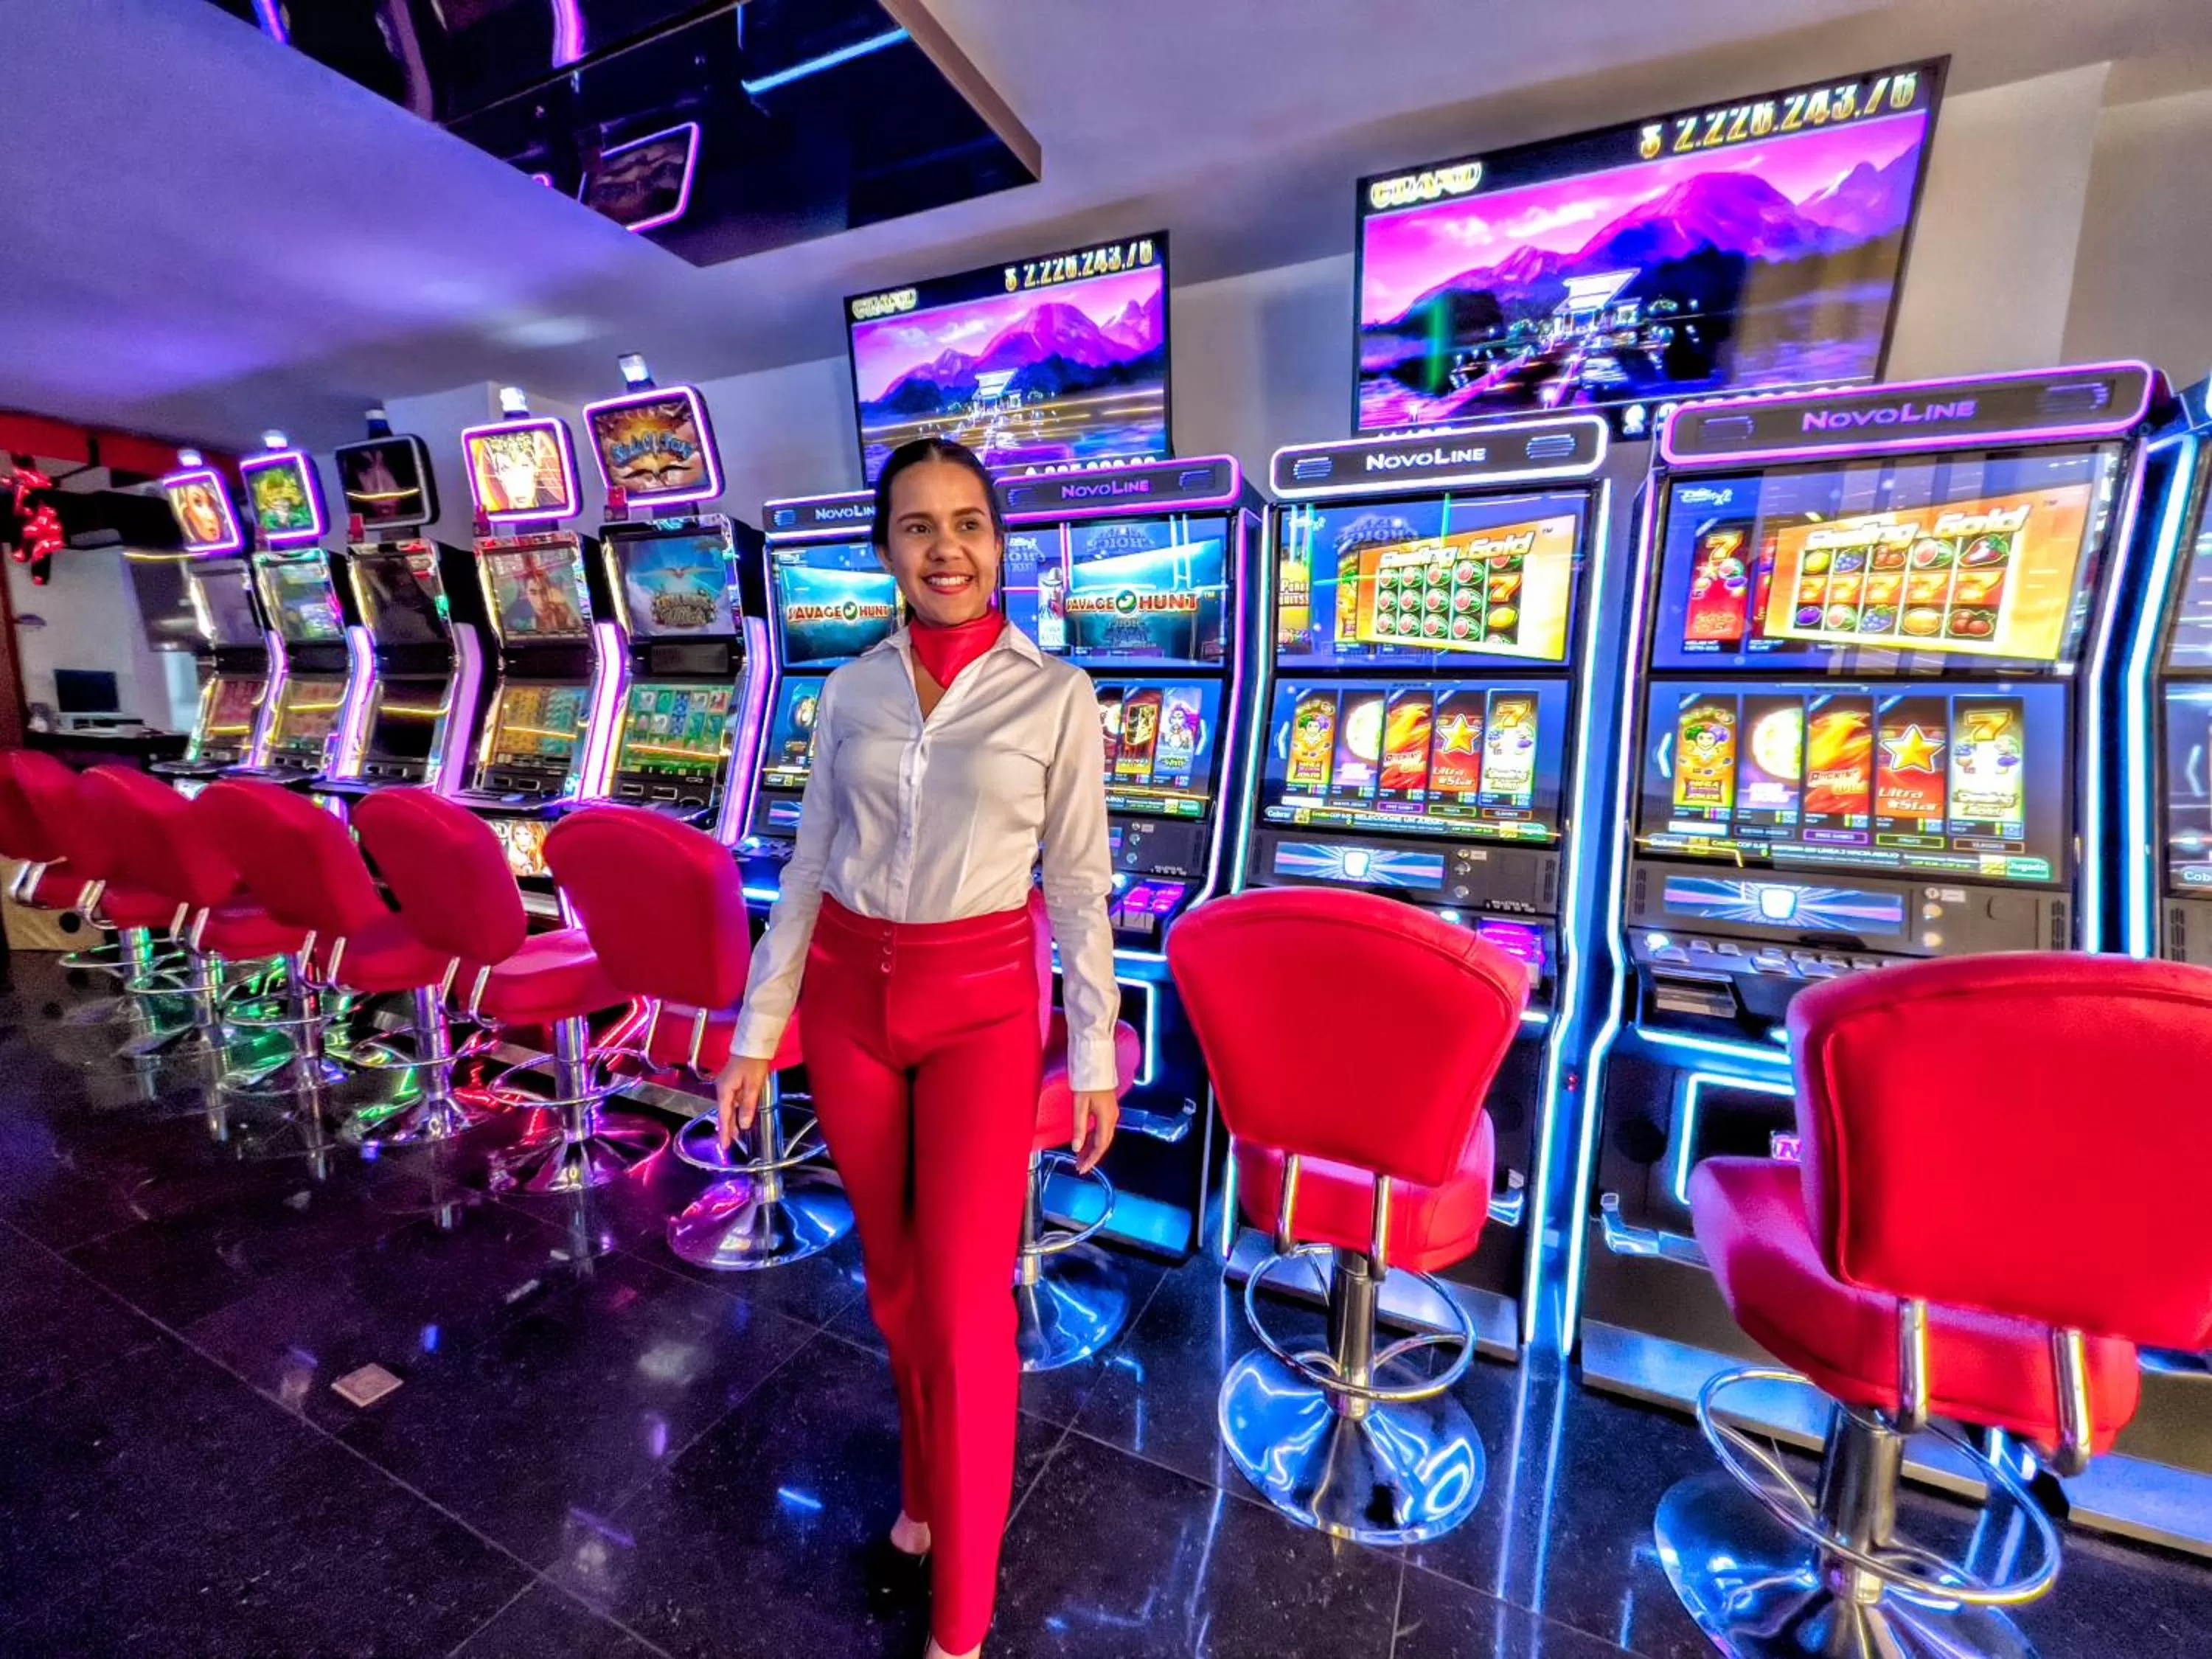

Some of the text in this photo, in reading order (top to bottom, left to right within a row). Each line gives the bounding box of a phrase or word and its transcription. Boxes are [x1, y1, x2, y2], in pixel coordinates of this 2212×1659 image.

[815, 504, 876, 520] NOVOLIN
[1138, 594, 1197, 611] HUNT
[859, 605, 888, 618] HUNT
[2183, 871, 2212, 883] Cob
